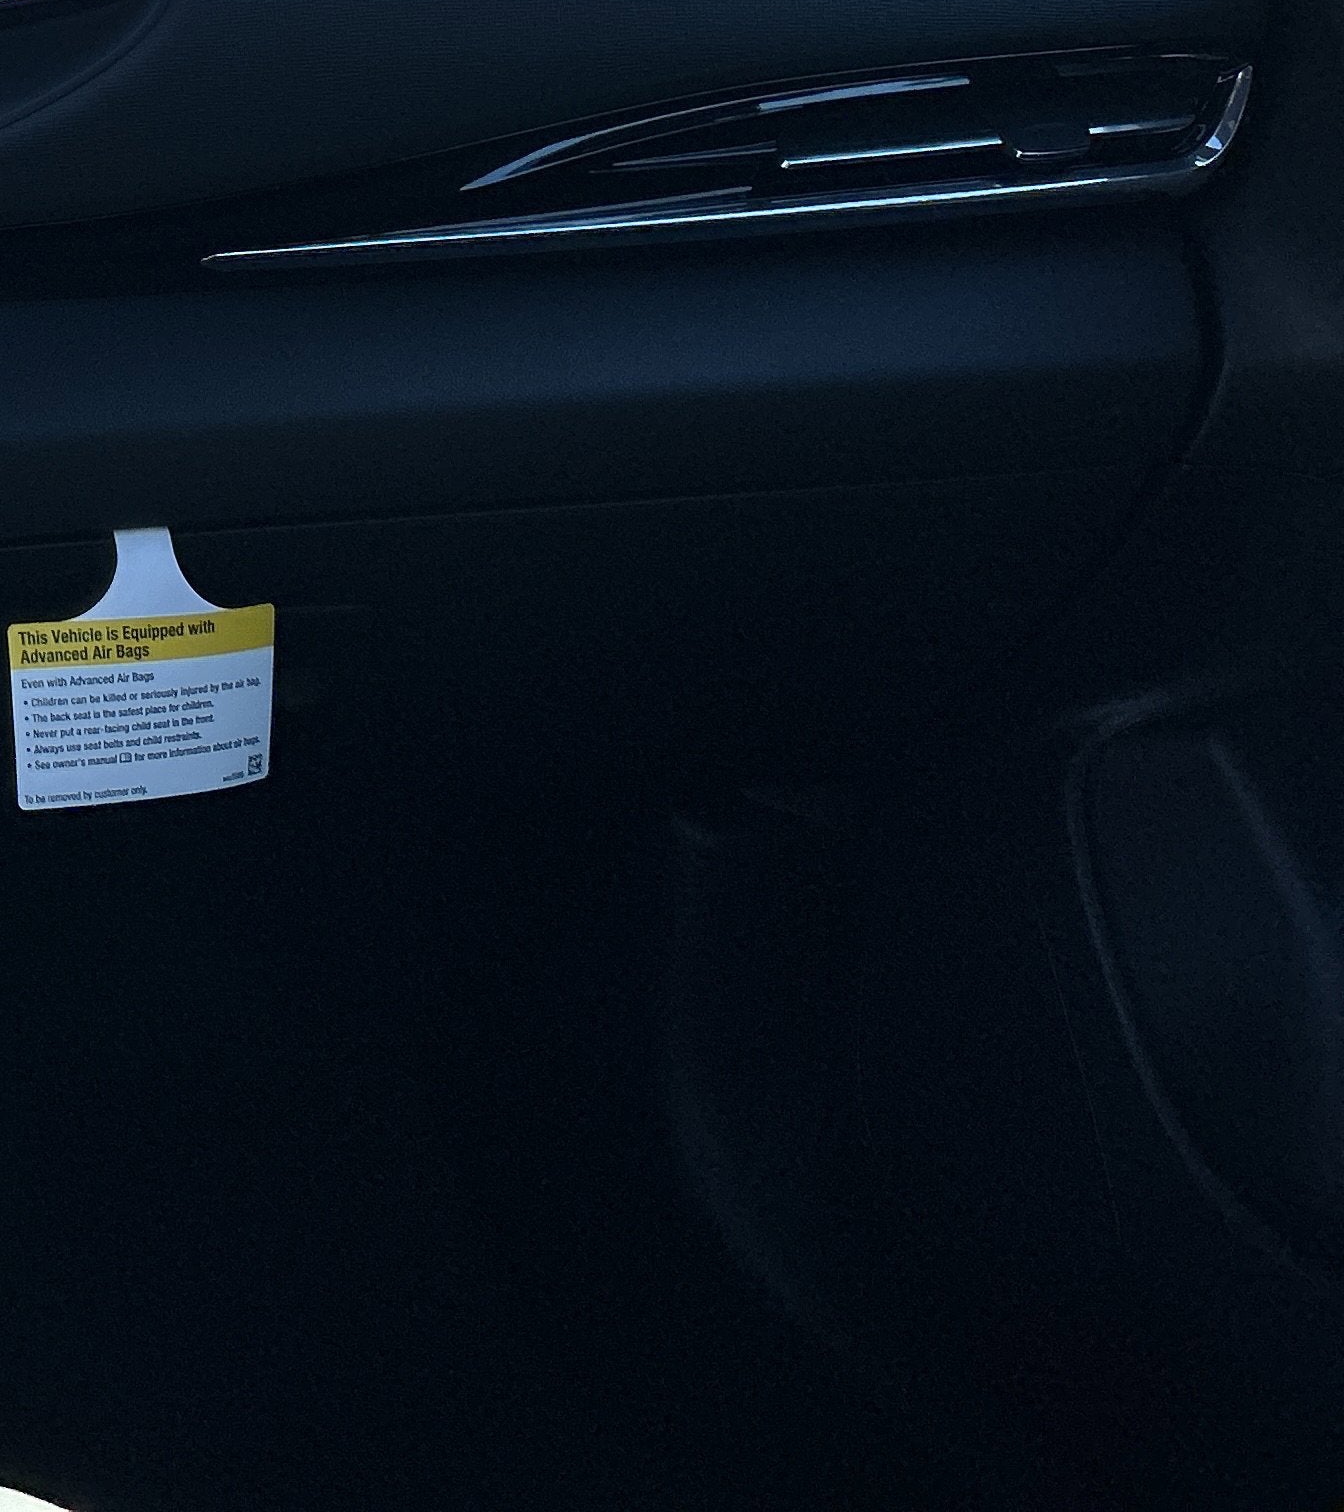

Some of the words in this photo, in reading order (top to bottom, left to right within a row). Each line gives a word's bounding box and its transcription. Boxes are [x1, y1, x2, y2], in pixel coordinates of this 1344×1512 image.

[18, 630, 48, 646] This
[51, 628, 102, 644] Vehicle
[105, 626, 119, 641] is
[122, 622, 183, 643] Equipped
[187, 619, 215, 635] with
[20, 647, 88, 665] Advanced
[92, 645, 111, 660] Air
[116, 643, 150, 661] Bags
[21, 678, 44, 689] Even
[47, 676, 67, 687] with
[69, 673, 114, 686] Advanced
[117, 672, 130, 683] Air
[132, 671, 154, 684] Bags
[31, 696, 68, 707] Children
[71, 696, 87, 705] can
[103, 692, 126, 702] killed
[141, 688, 178, 700] seriously
[180, 685, 208, 697] injured
[33, 713, 48, 723] The
[50, 711, 71, 721] back
[73, 710, 92, 720] seat
[102, 708, 116, 719] the
[118, 706, 143, 717] safest
[144, 705, 167, 716] place
[169, 703, 180, 713] for
[33, 728, 57, 739] Never
[60, 727, 75, 738] put
[132, 721, 151, 731] child
[153, 719, 170, 729] seat
[33, 744, 64, 755] Always
[66, 743, 82, 753] use
[84, 741, 102, 751] seat
[104, 739, 124, 750] belts
[126, 737, 141, 748] and
[143, 735, 162, 746] child
[34, 759, 50, 770] See
[52, 757, 85, 768] owner's
[88, 754, 118, 766] manual
[134, 751, 145, 762] for
[147, 750, 168, 761] more
[169, 745, 211, 760] information
[25, 795, 34, 805] To
[35, 793, 46, 804] be
[47, 790, 81, 802] removed
[94, 787, 129, 799] customer
